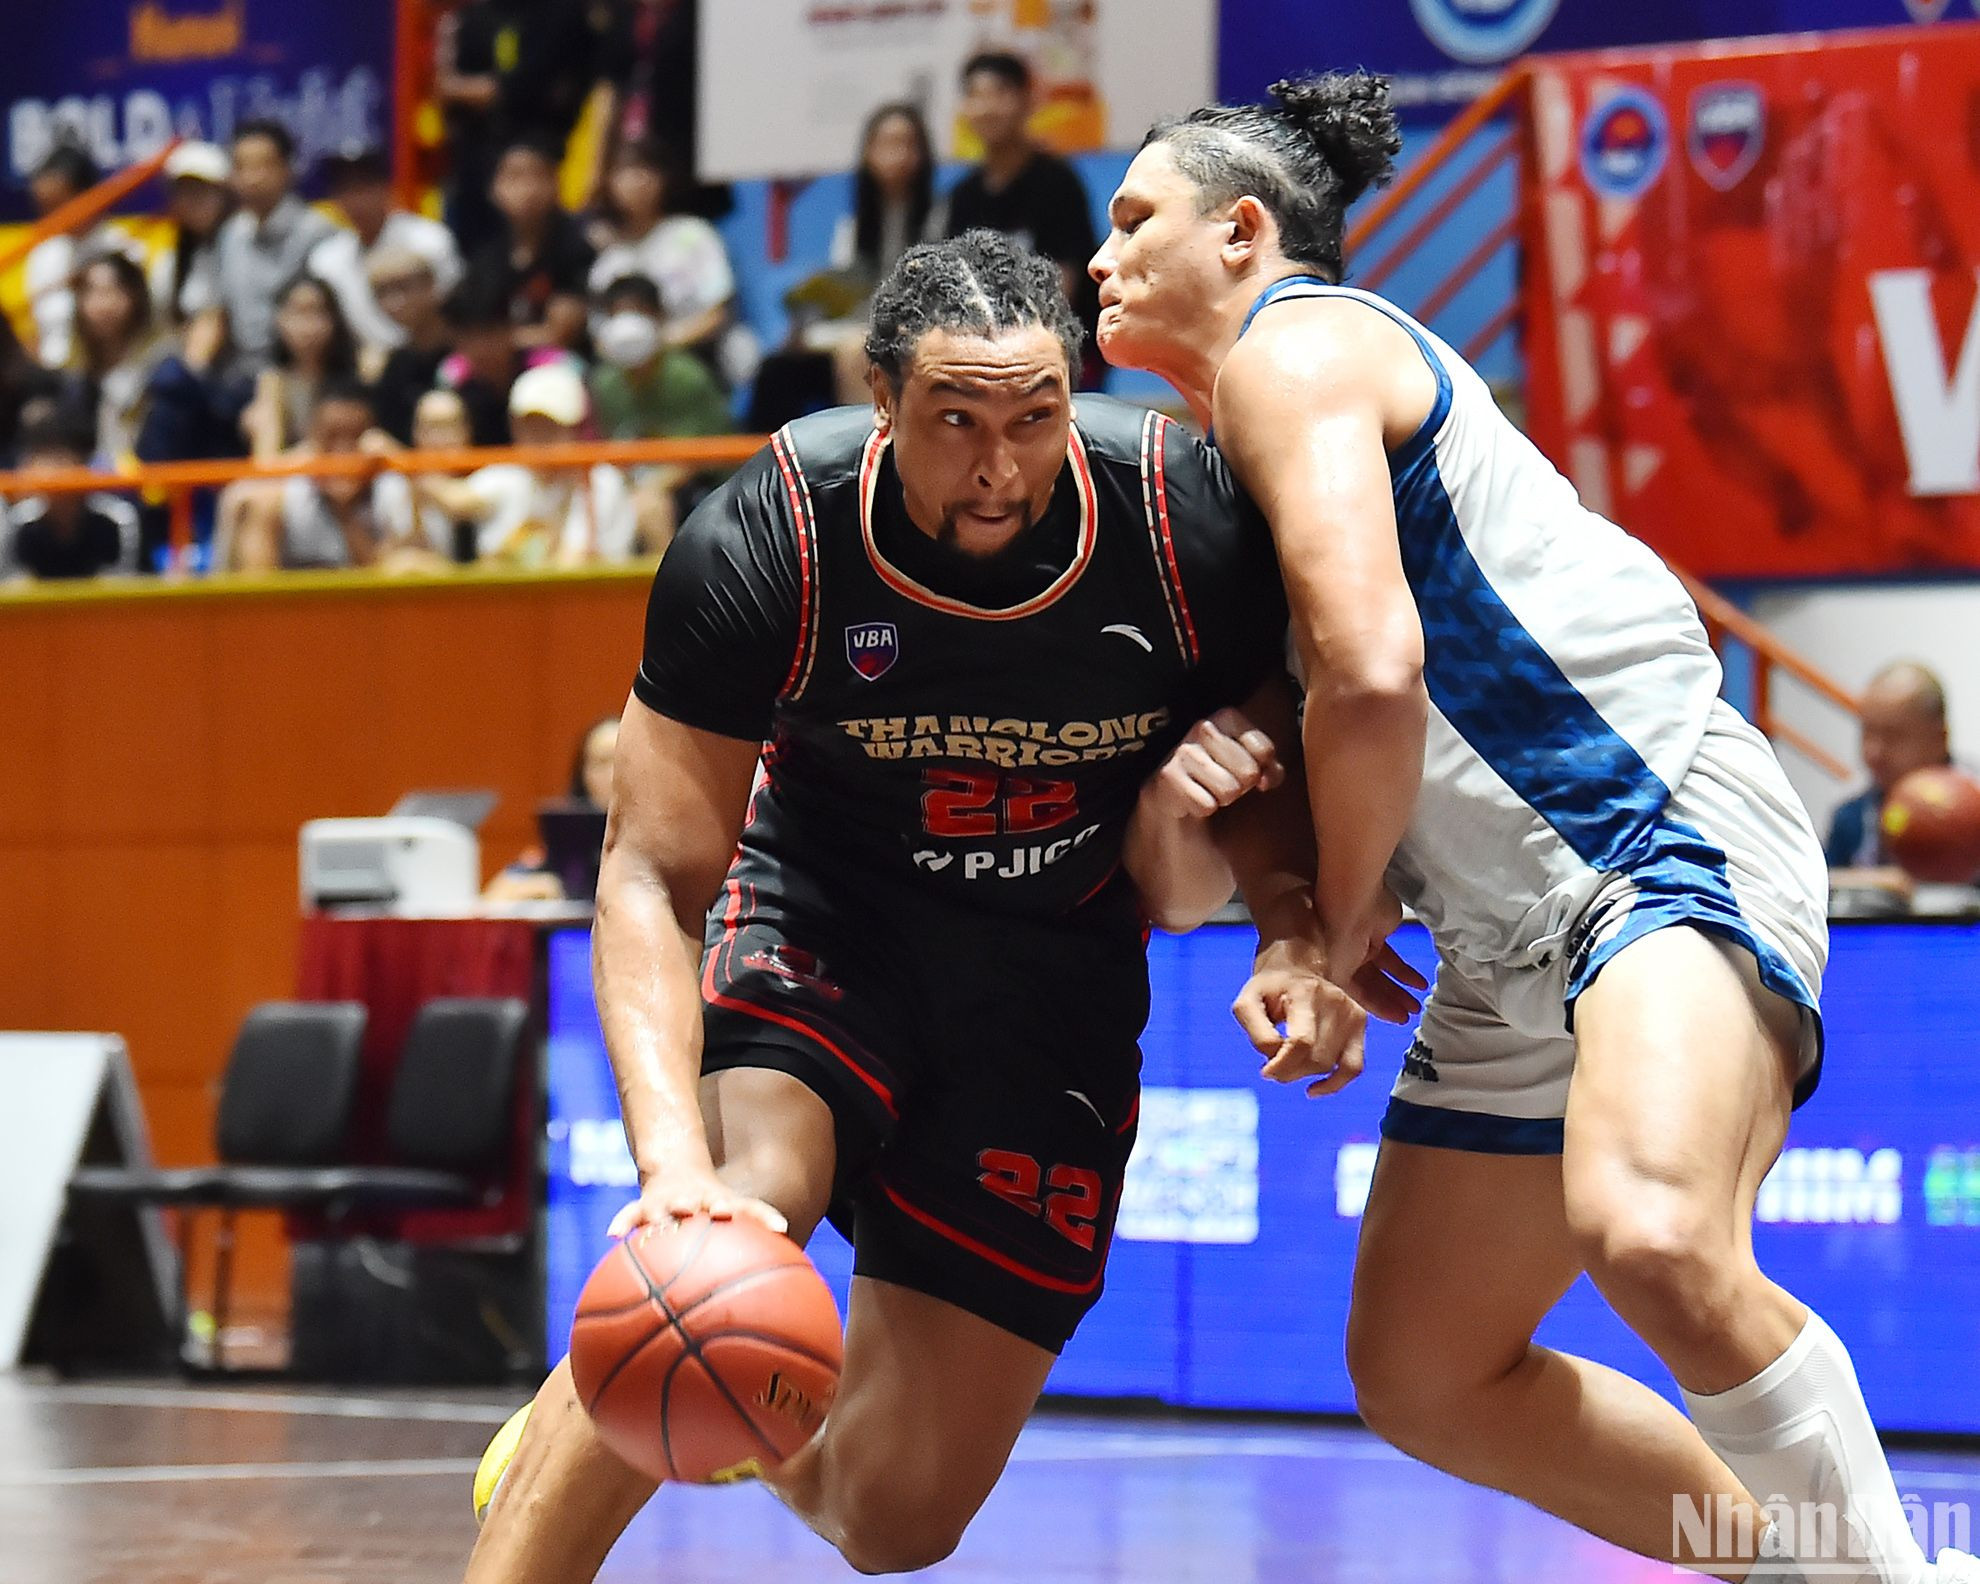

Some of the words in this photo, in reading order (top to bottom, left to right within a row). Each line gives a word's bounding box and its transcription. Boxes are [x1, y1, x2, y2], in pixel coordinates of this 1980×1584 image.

[852, 629, 894, 649] VBA
[921, 768, 1079, 837] 22
[976, 1147, 1102, 1251] 22
